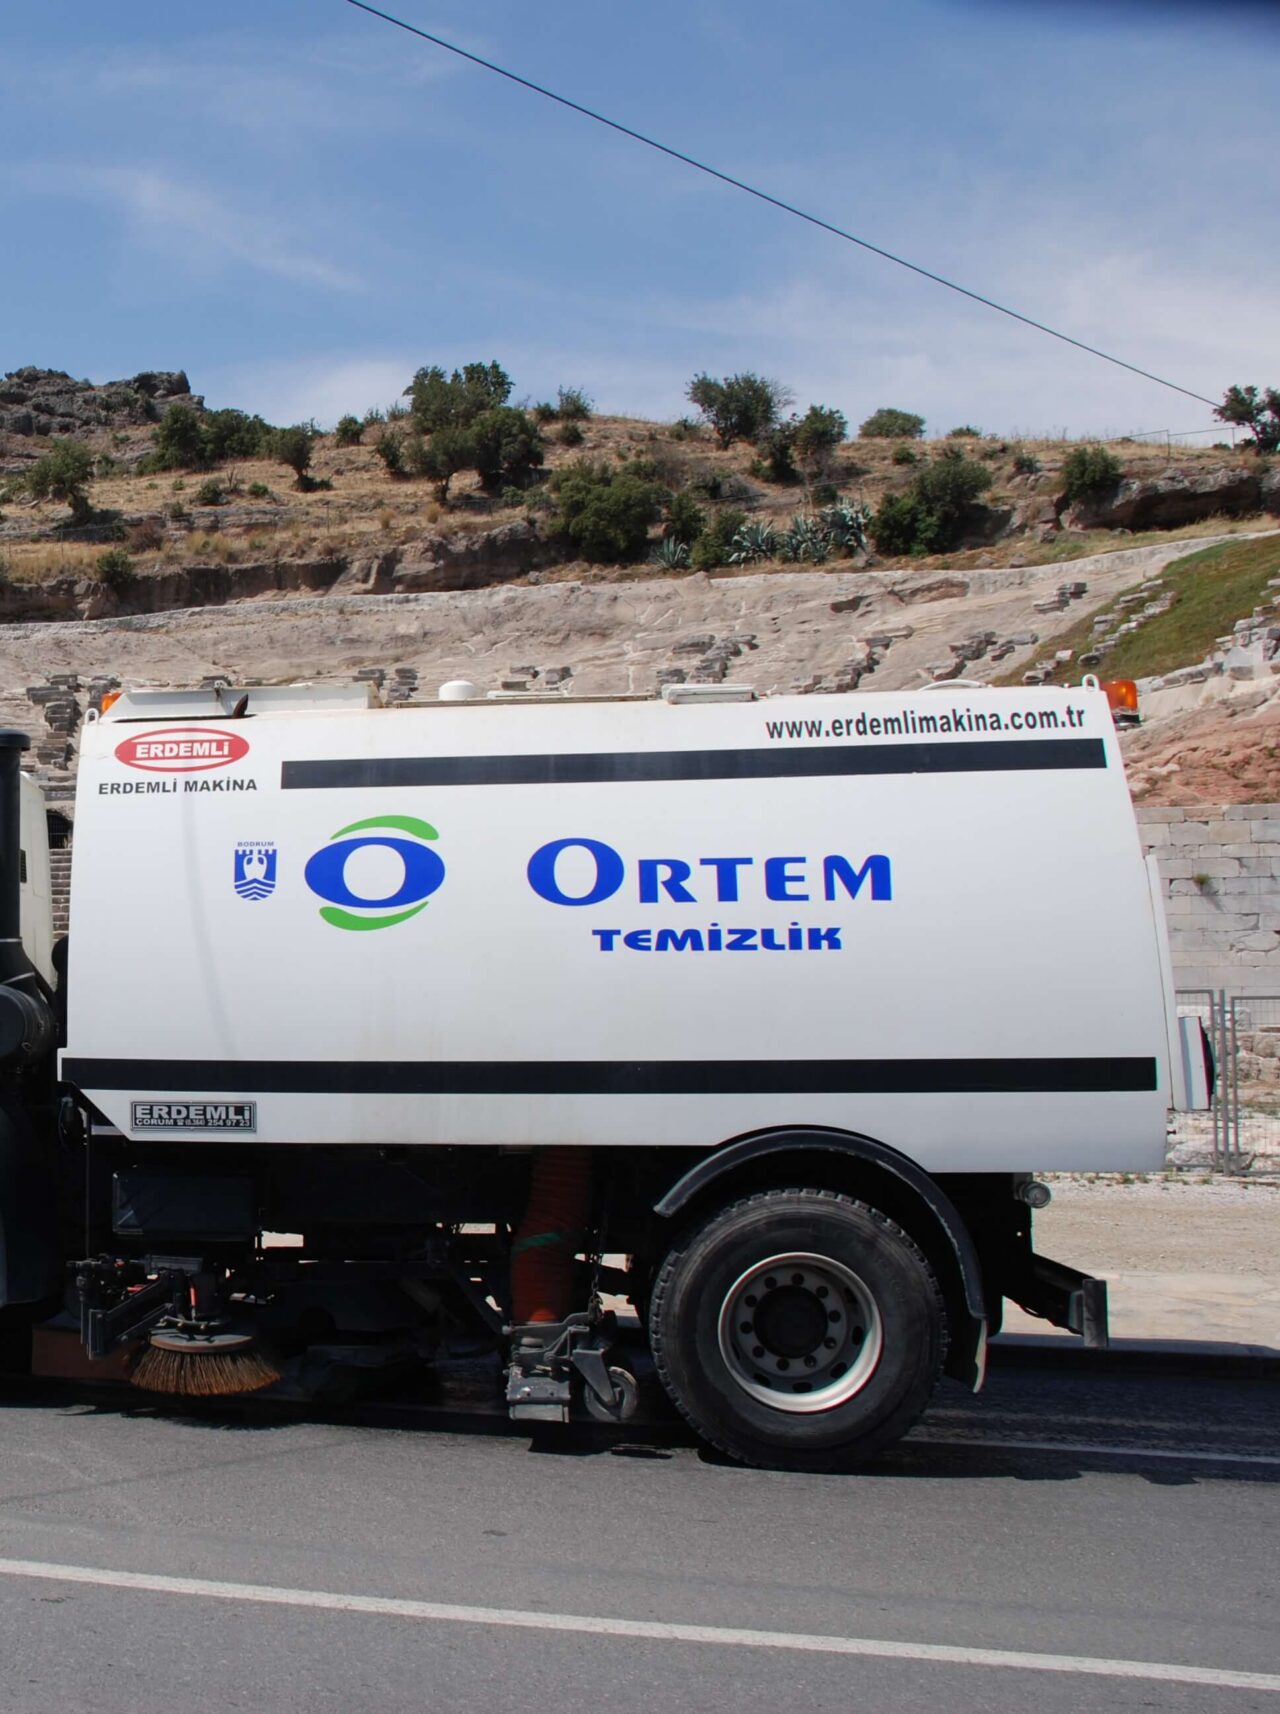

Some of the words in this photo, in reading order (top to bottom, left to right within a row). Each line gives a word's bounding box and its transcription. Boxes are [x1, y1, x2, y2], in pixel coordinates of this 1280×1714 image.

[766, 705, 1085, 739] www.erdemlimakina.com.tr
[184, 776, 258, 793] MAKİNA
[527, 837, 893, 907] ORTEM
[591, 922, 843, 952] TEMİZLİK
[208, 1119, 224, 1127] 254
